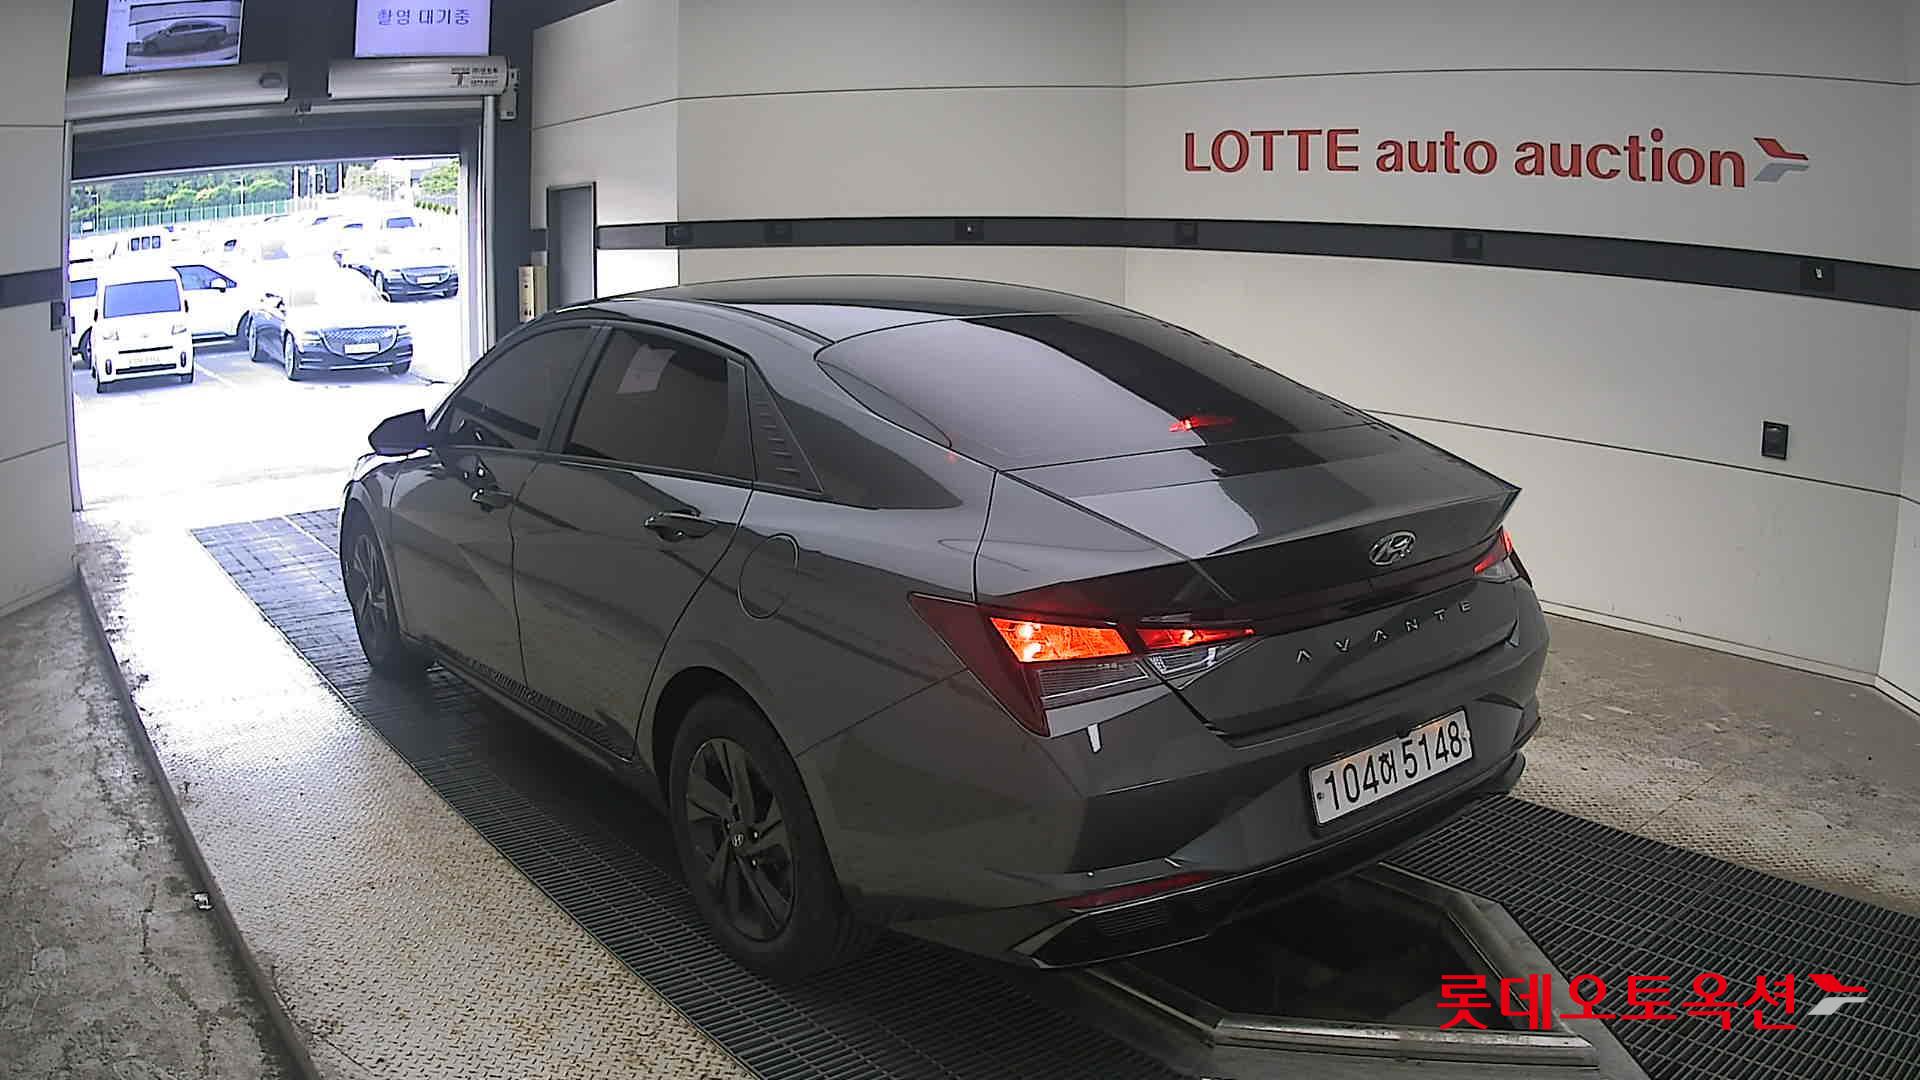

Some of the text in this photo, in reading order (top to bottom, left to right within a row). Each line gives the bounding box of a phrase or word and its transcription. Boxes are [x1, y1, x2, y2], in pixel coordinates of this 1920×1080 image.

[419, 8, 470, 26] 대기중
[1184, 128, 1746, 188] LOTTE auto auction
[1296, 600, 1472, 664] AVANTE
